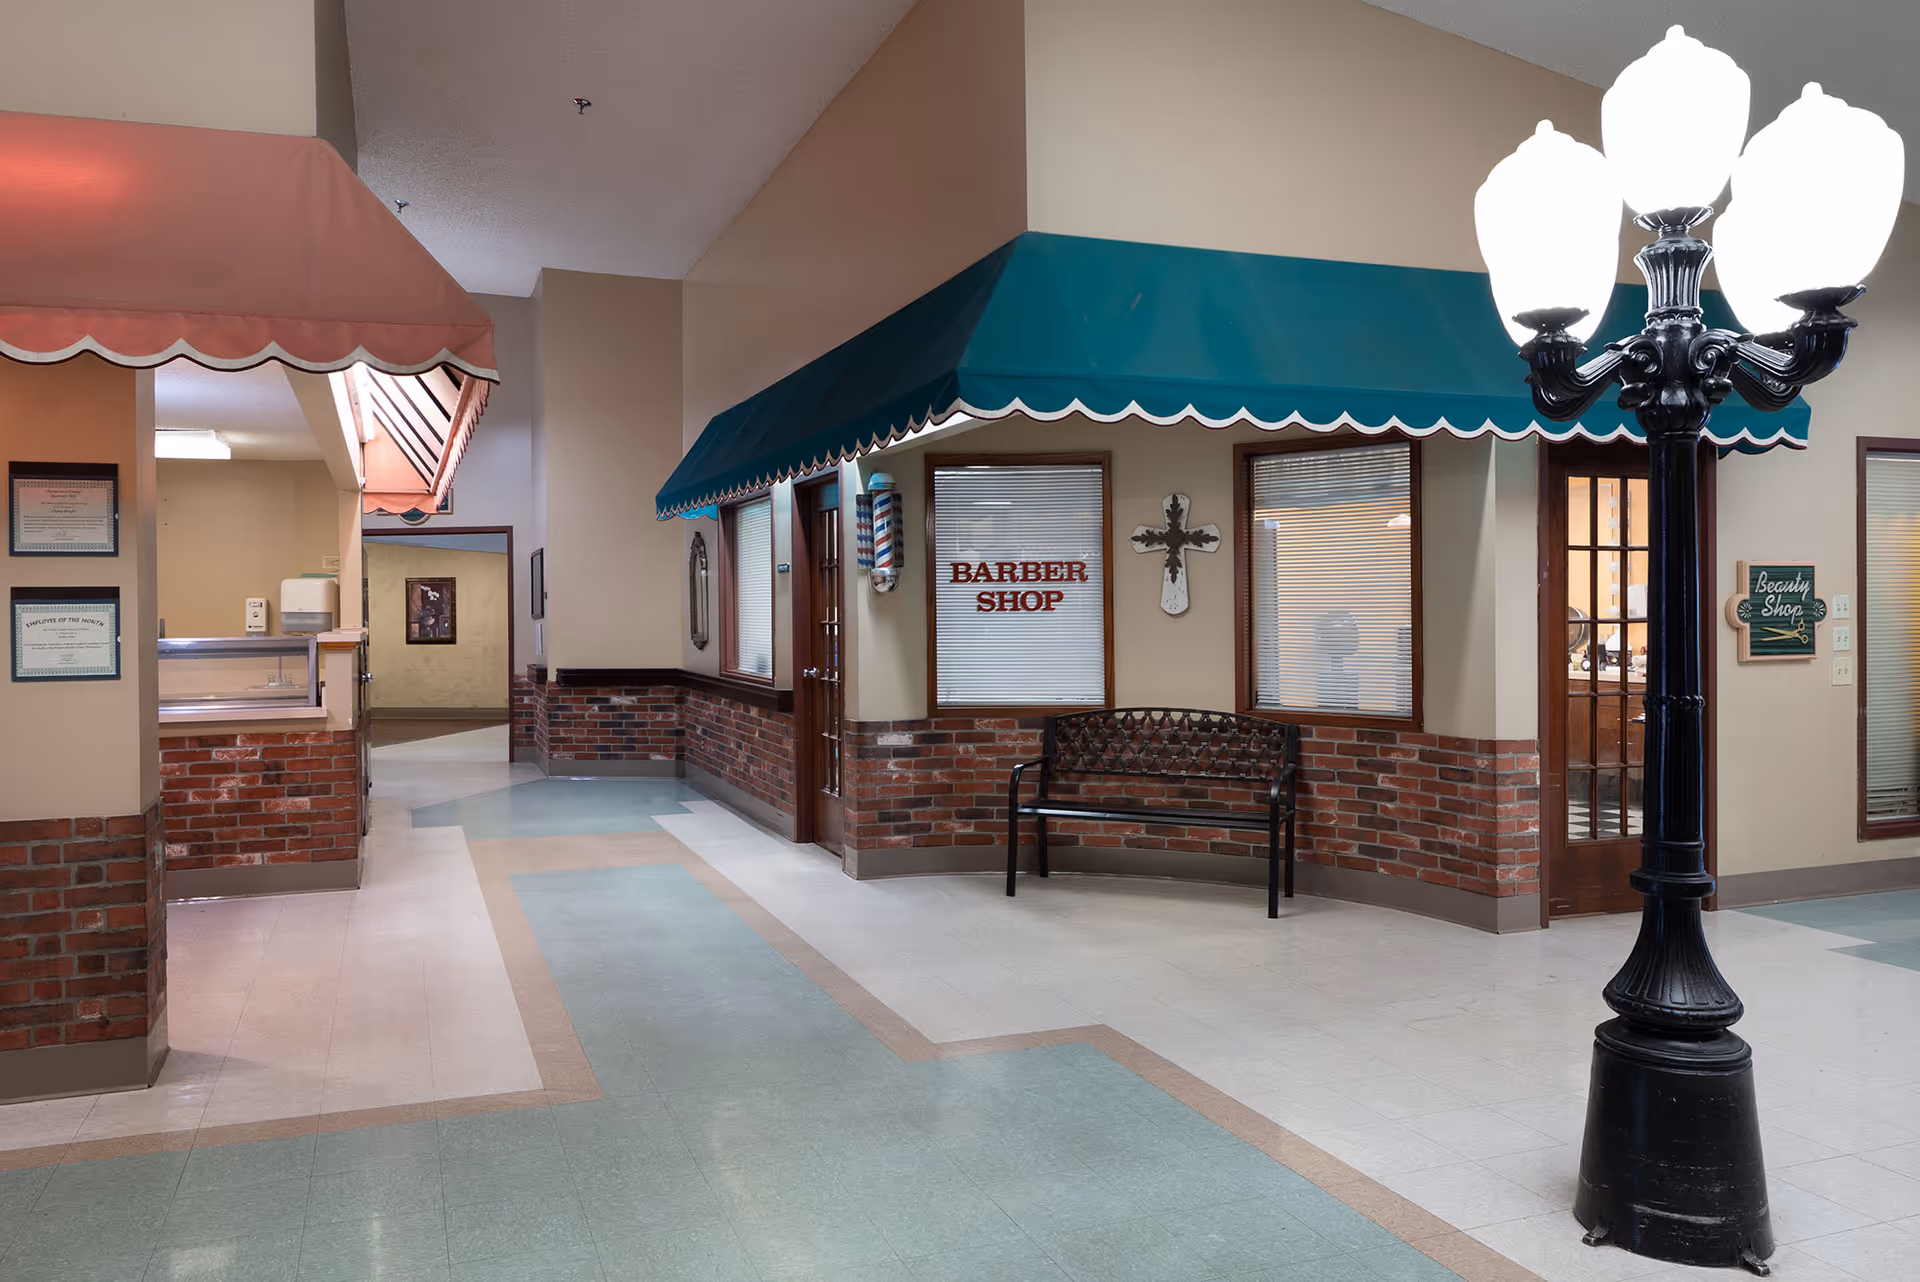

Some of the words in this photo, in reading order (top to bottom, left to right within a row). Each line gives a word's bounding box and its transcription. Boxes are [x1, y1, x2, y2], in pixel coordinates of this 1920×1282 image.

[950, 561, 1088, 583] BARBER
[1755, 571, 1810, 601] Beauty
[976, 590, 1064, 612] SHOP
[1761, 594, 1803, 625] Shop
[25, 617, 57, 628] EMPLOYEE
[81, 618, 105, 628] MONTH
